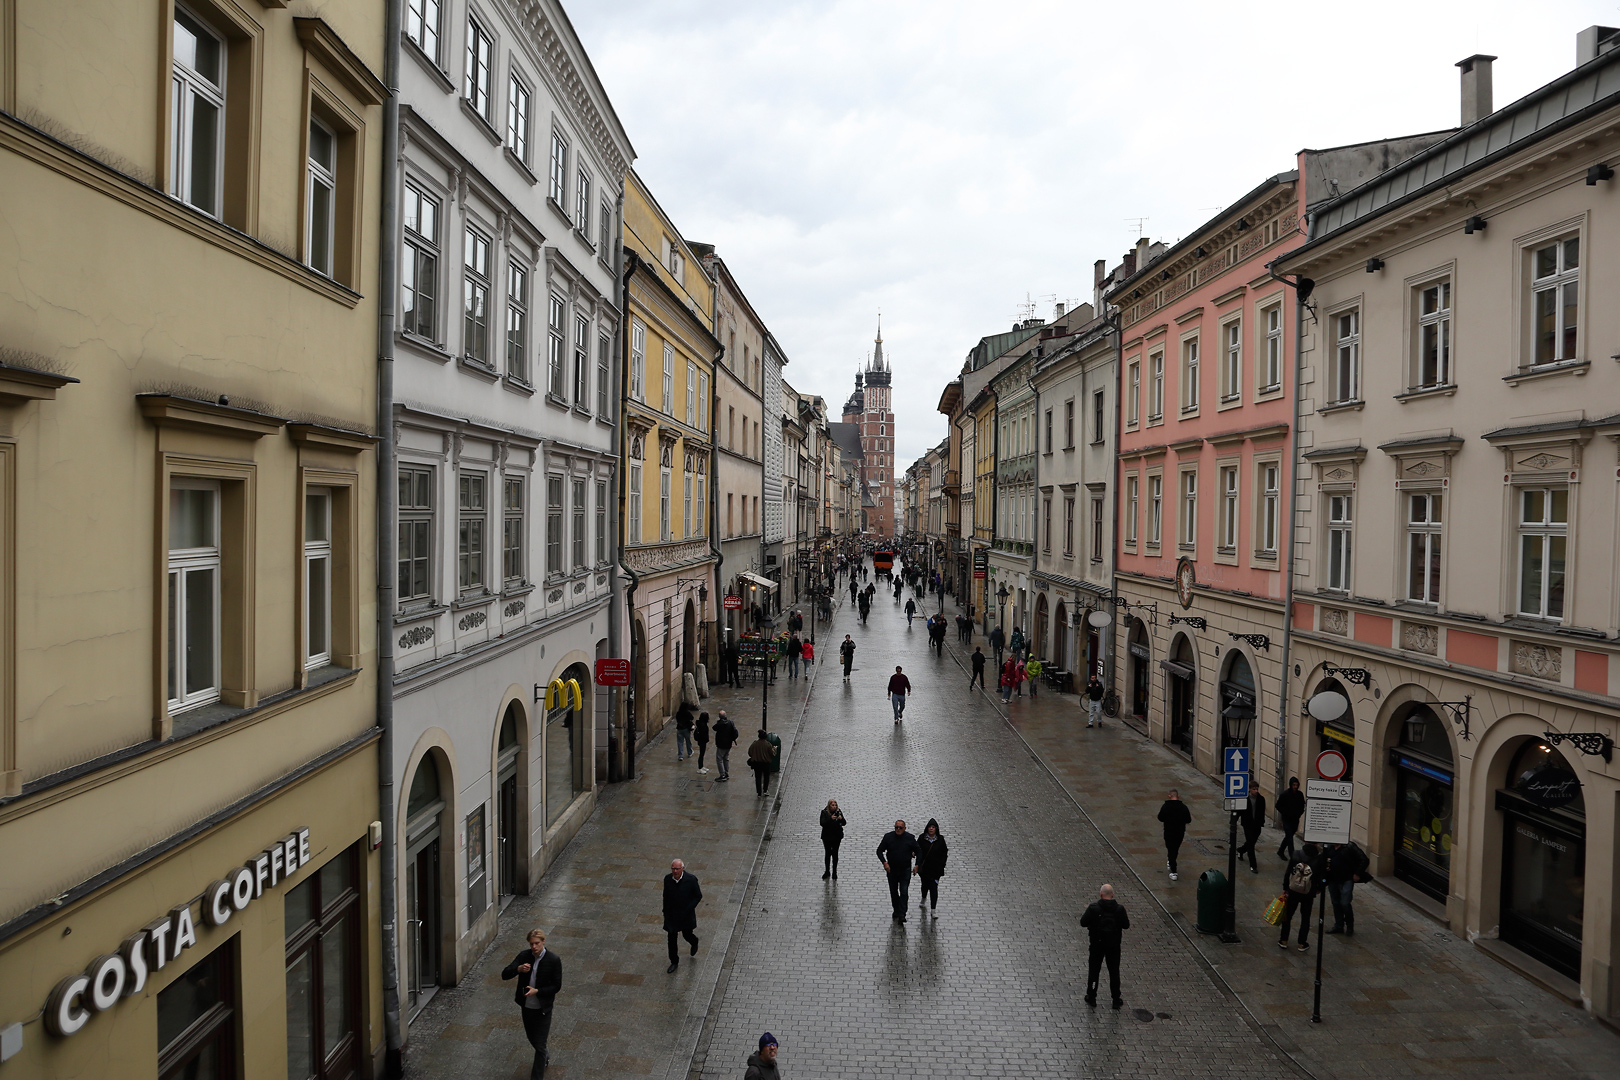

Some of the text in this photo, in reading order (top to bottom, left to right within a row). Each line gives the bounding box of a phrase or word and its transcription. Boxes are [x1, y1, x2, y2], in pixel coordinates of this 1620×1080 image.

[1229, 775, 1244, 795] P
[1516, 826, 1567, 853] GALERIA LAMPERT
[50, 826, 311, 1037] COSTA COFFEE
